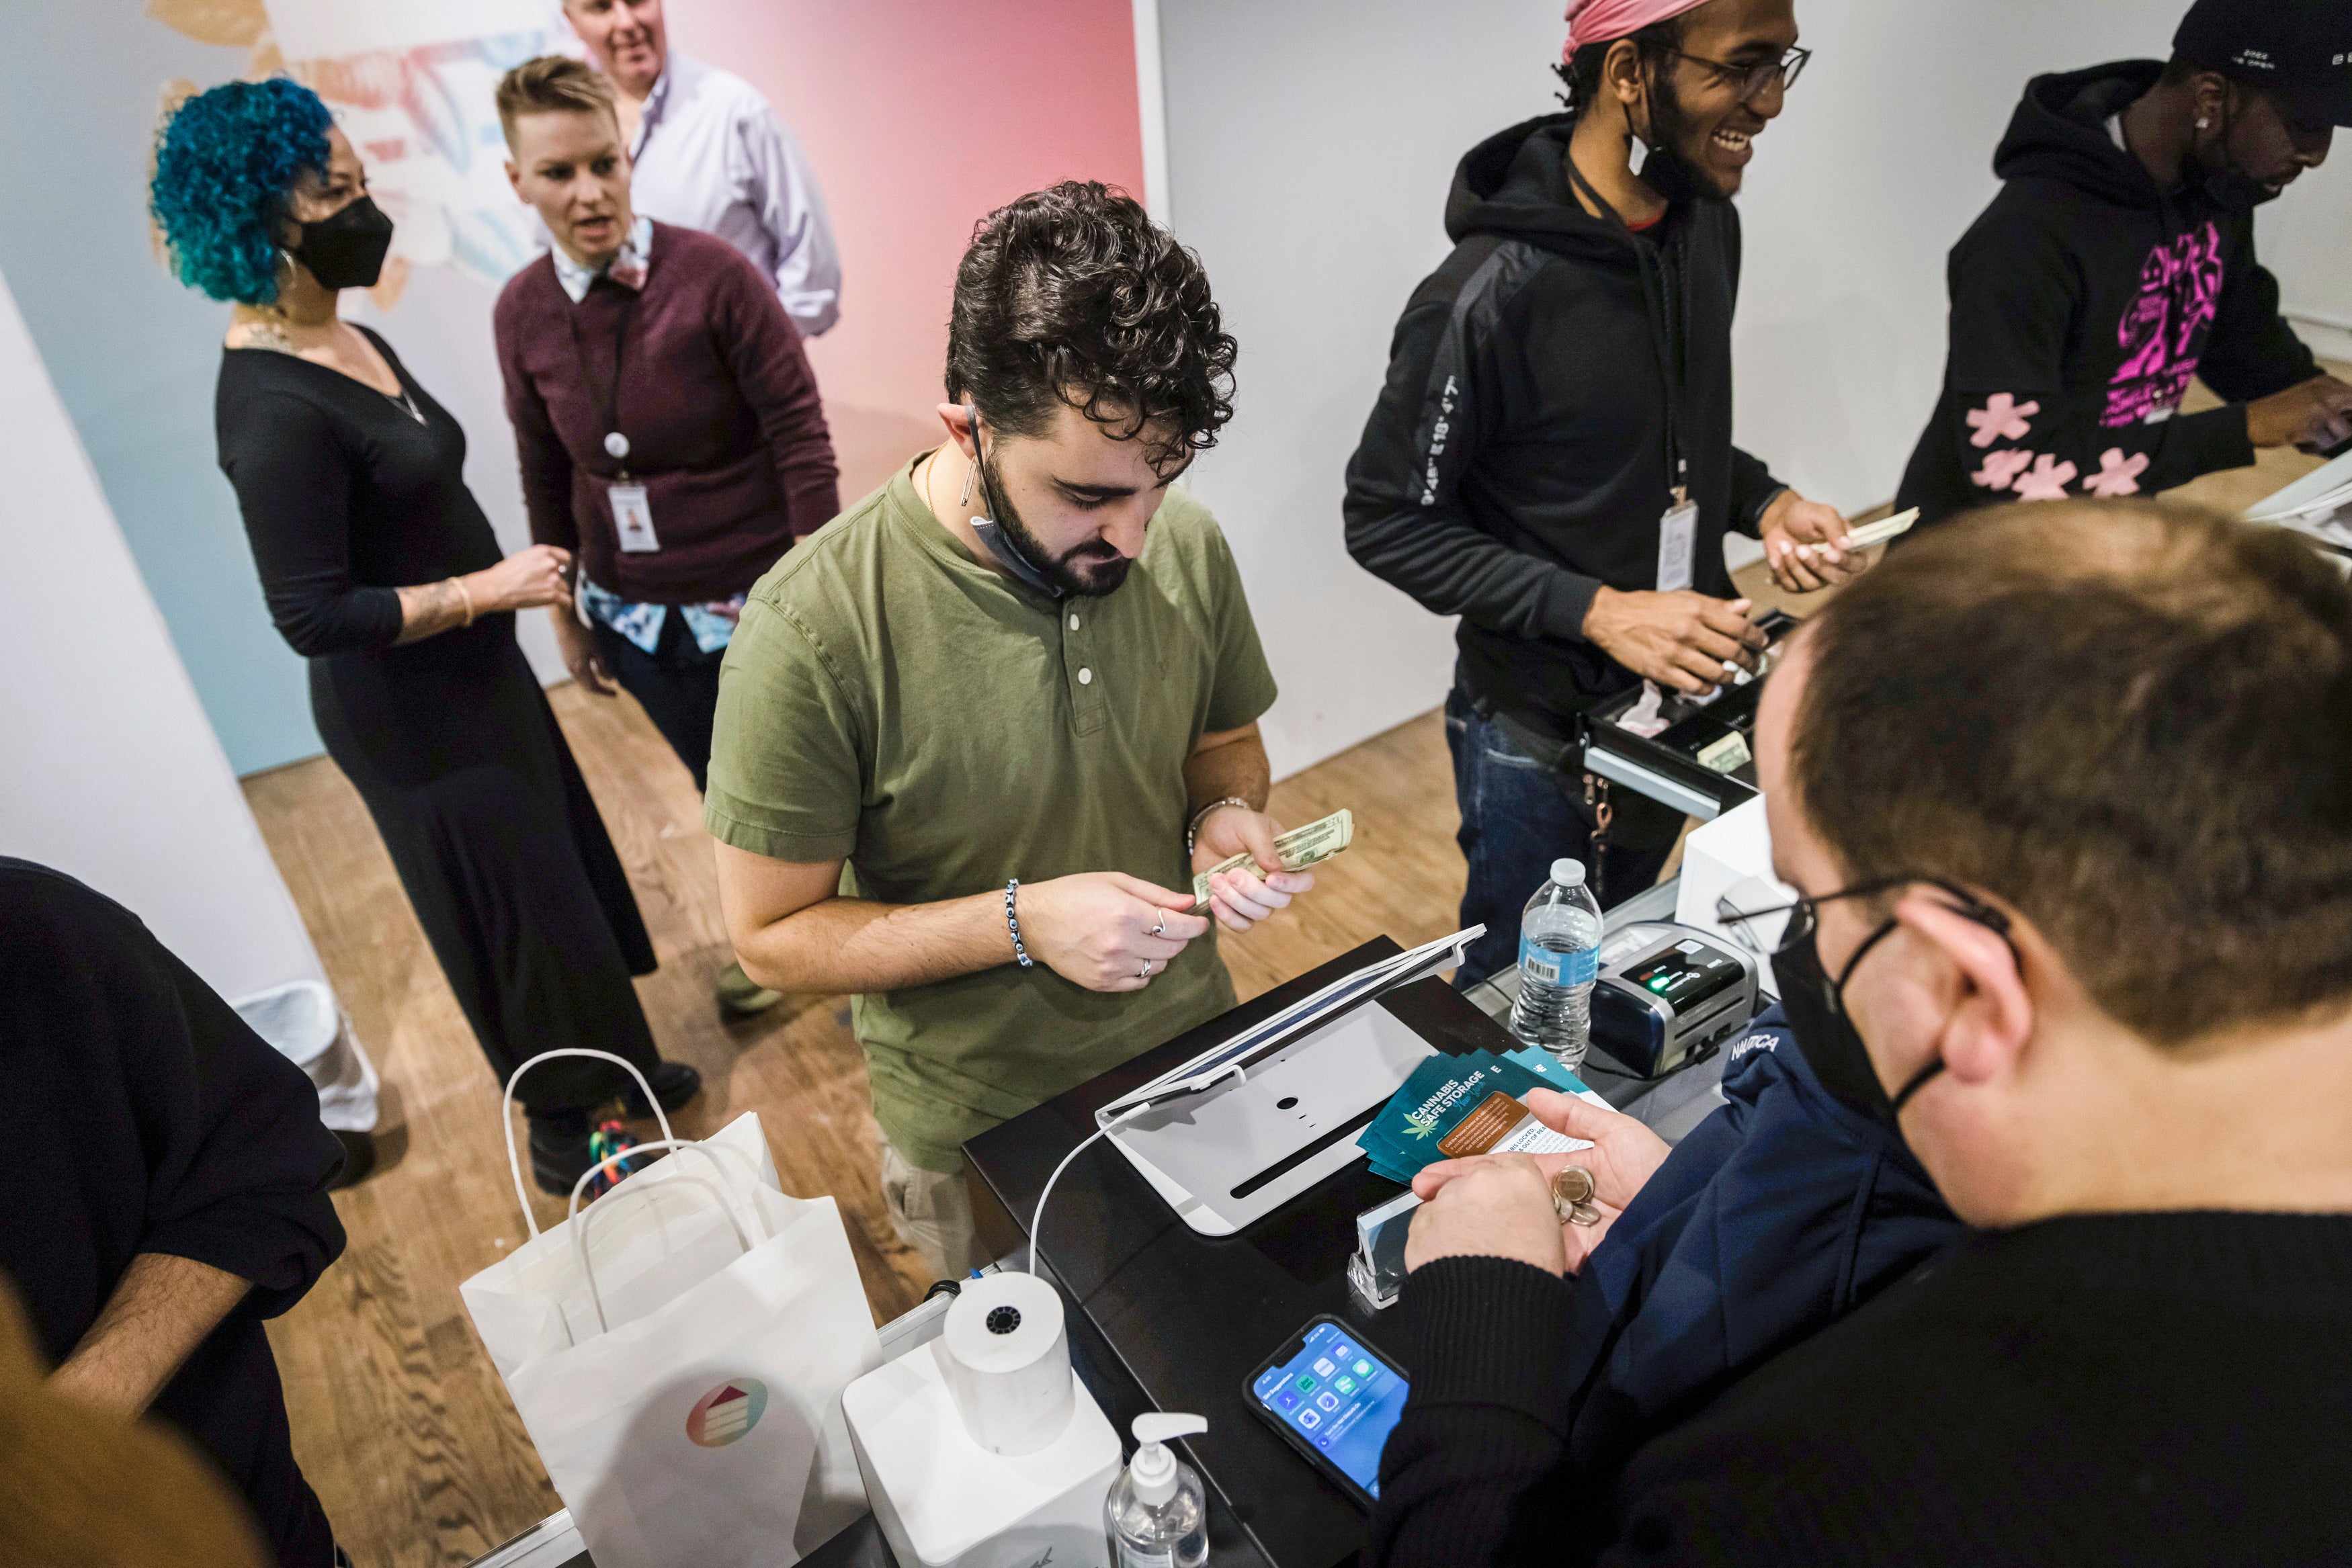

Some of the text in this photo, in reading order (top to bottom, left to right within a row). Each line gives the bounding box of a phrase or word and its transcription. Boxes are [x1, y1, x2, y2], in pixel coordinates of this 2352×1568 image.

[1731, 1034, 1780, 1061] NAUTICA
[1411, 1079, 1459, 1121] CANNABIS
[1420, 1070, 1485, 1127] SAFE STORAGE
[1455, 1127, 1467, 1138] Poison
[1464, 1119, 1476, 1130] Center
[1457, 1135, 1466, 1143] think
[1464, 1125, 1478, 1137] someone
[1468, 1129, 1482, 1141] product
[1482, 1124, 1495, 1135] person
[1516, 1126, 1536, 1145] LOCKED,
[1521, 1139, 1531, 1149] OUT
[1530, 1133, 1538, 1141] OF
[1268, 1372, 1295, 1395] Suggestions
